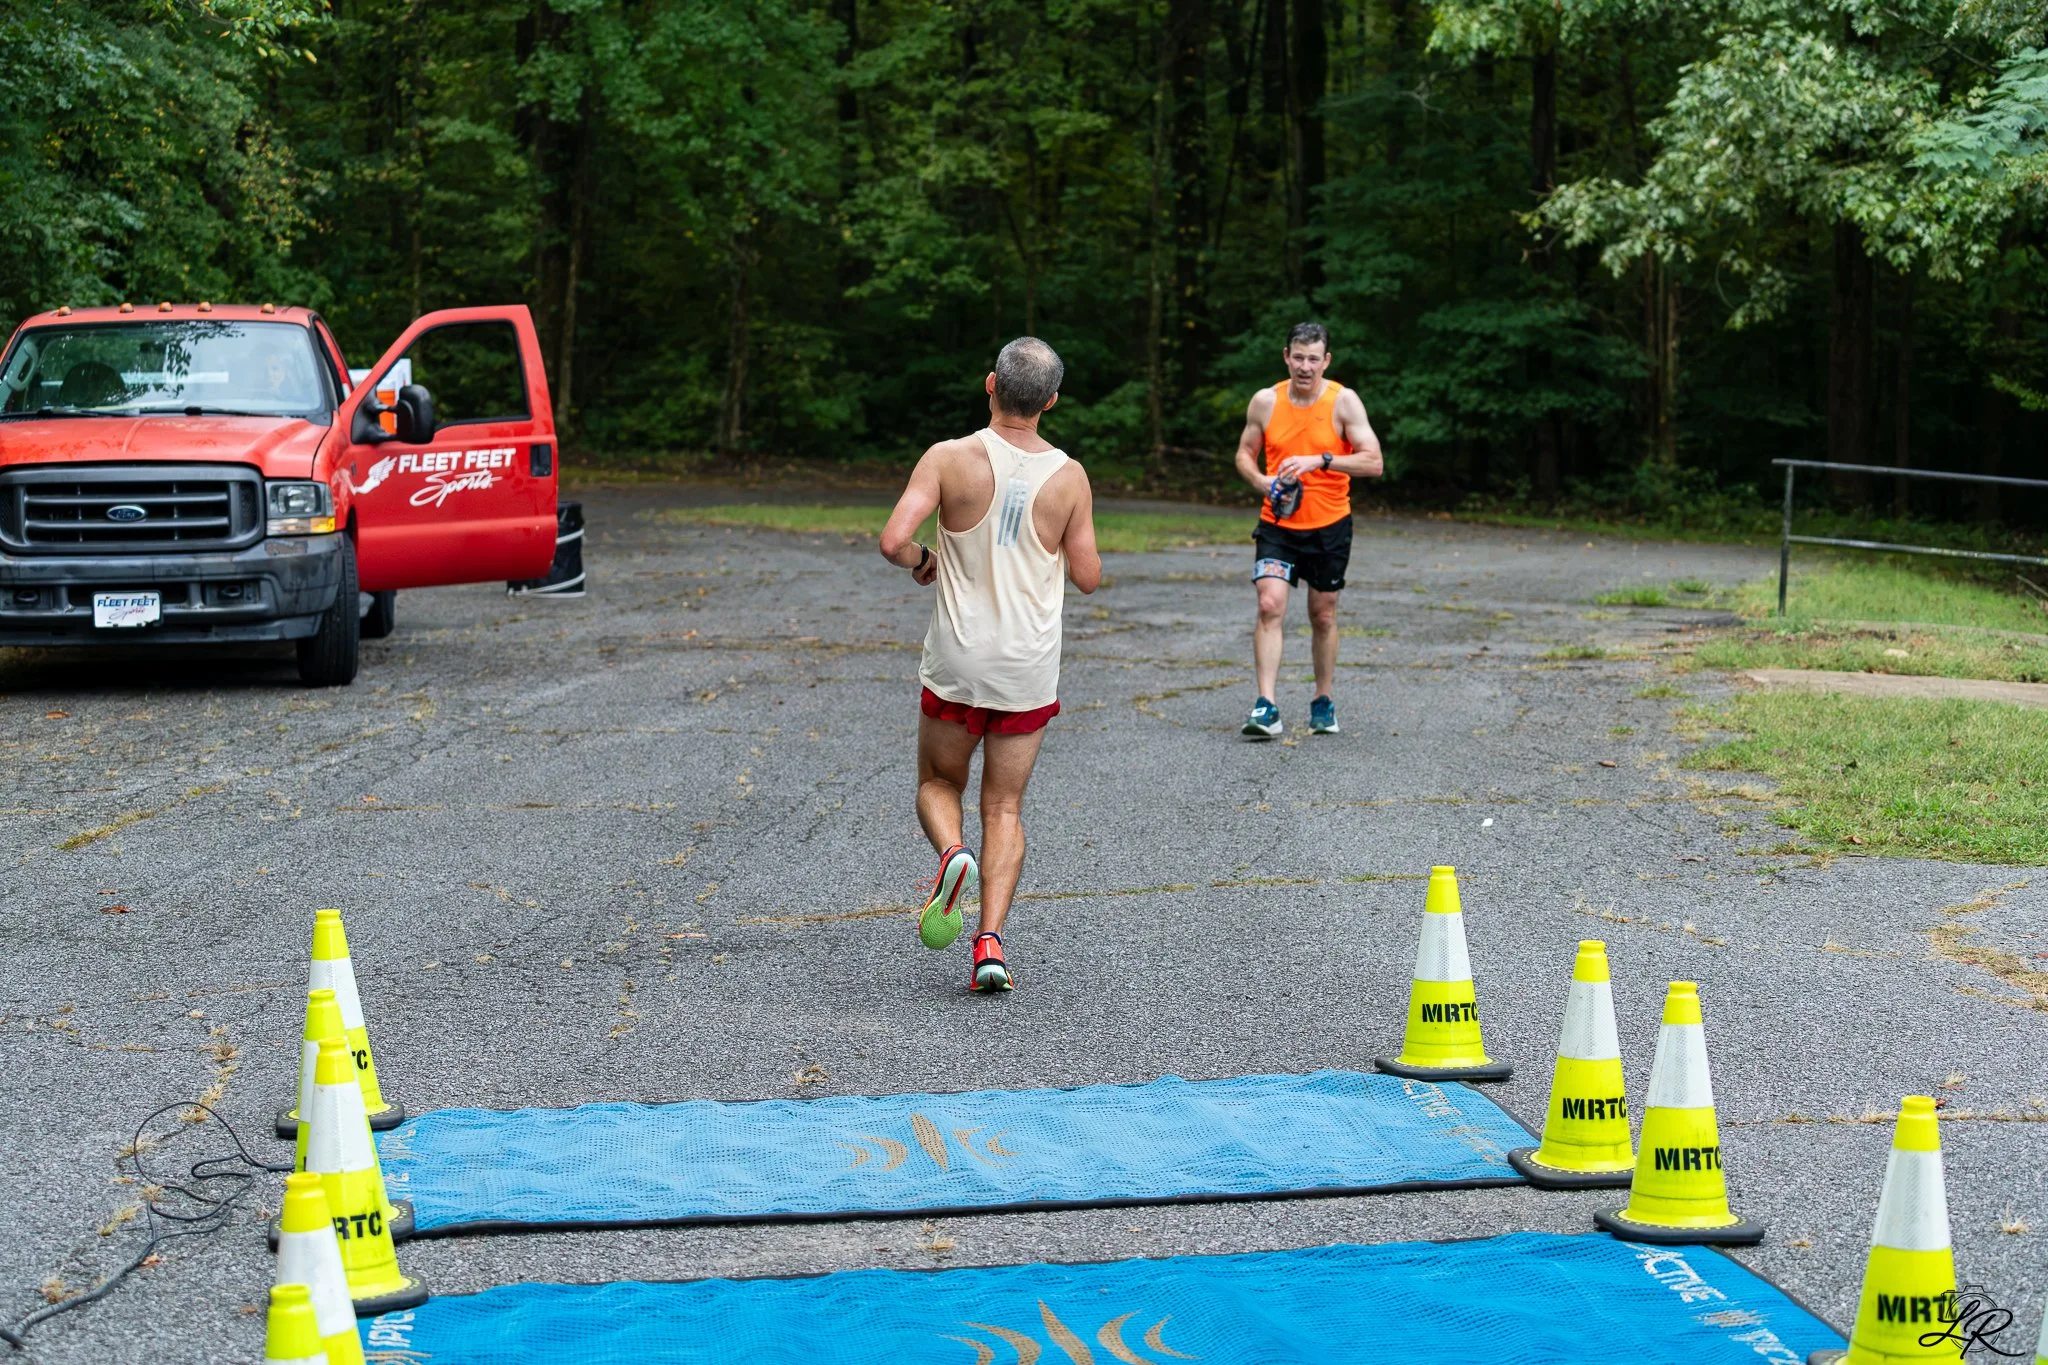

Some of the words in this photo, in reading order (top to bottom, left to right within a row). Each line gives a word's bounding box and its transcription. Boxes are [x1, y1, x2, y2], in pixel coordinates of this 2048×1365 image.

[398, 451, 461, 473] FLEET
[464, 448, 516, 469] FEET
[409, 469, 503, 508] Sports
[97, 598, 129, 607] FLEET
[131, 598, 157, 607] FEET
[1422, 1003, 1478, 1023] MRTC
[1562, 1097, 1627, 1120] MRTC
[1655, 1145, 1722, 1171] MRTC
[333, 1210, 383, 1240] RTC
